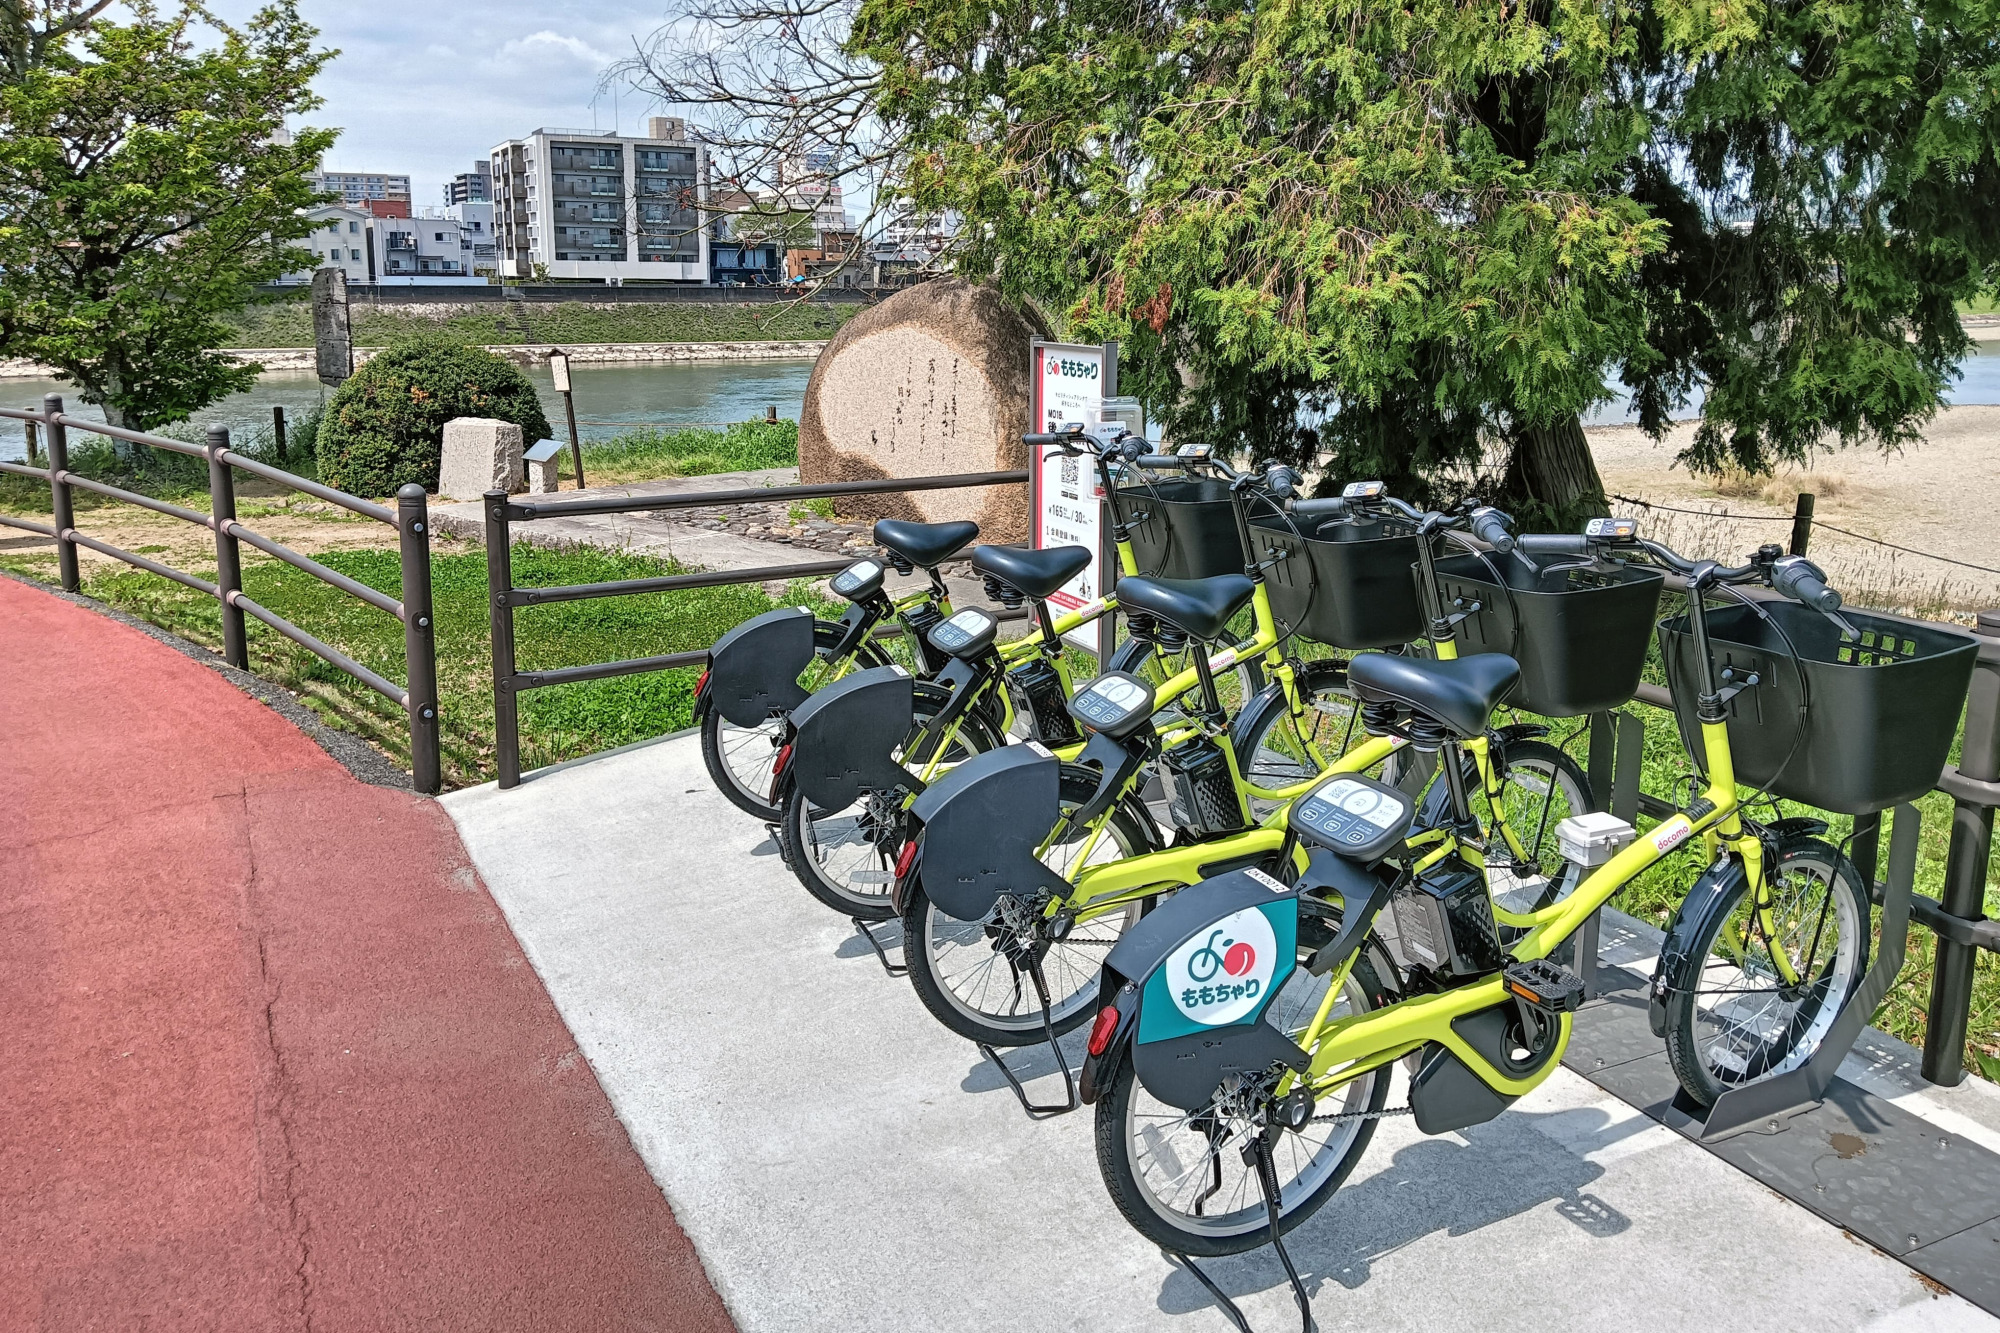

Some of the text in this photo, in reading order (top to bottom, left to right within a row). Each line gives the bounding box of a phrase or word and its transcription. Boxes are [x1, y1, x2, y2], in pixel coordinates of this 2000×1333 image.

[1061, 358, 1099, 380] ももちゃり
[1081, 603, 1104, 617] docomo
[1657, 825, 1689, 850] docomo
[1181, 978, 1260, 1009] ももちゃり
